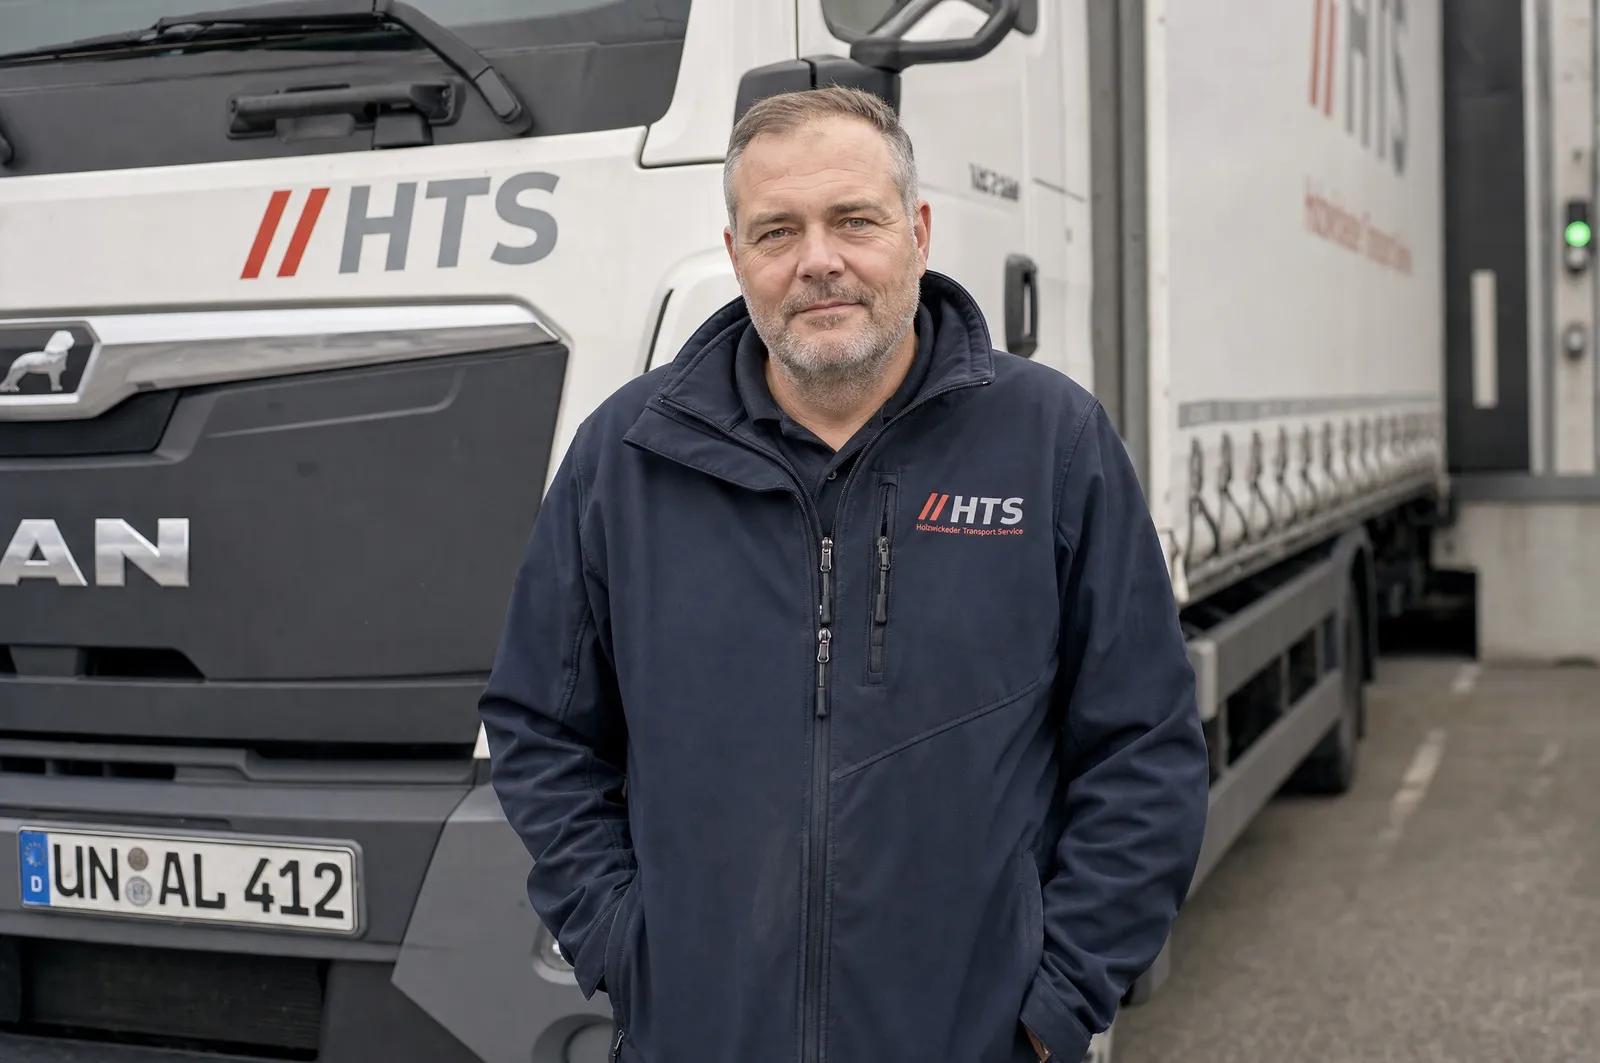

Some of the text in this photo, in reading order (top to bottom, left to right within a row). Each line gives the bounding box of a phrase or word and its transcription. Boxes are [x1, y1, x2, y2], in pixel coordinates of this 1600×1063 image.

[339, 171, 560, 275] HTS
[950, 495, 1024, 525] HTS
[916, 523, 1024, 537] Holzwickeder Transport Service
[31, 875, 43, 893] D
[53, 843, 345, 920] UN AL 412
